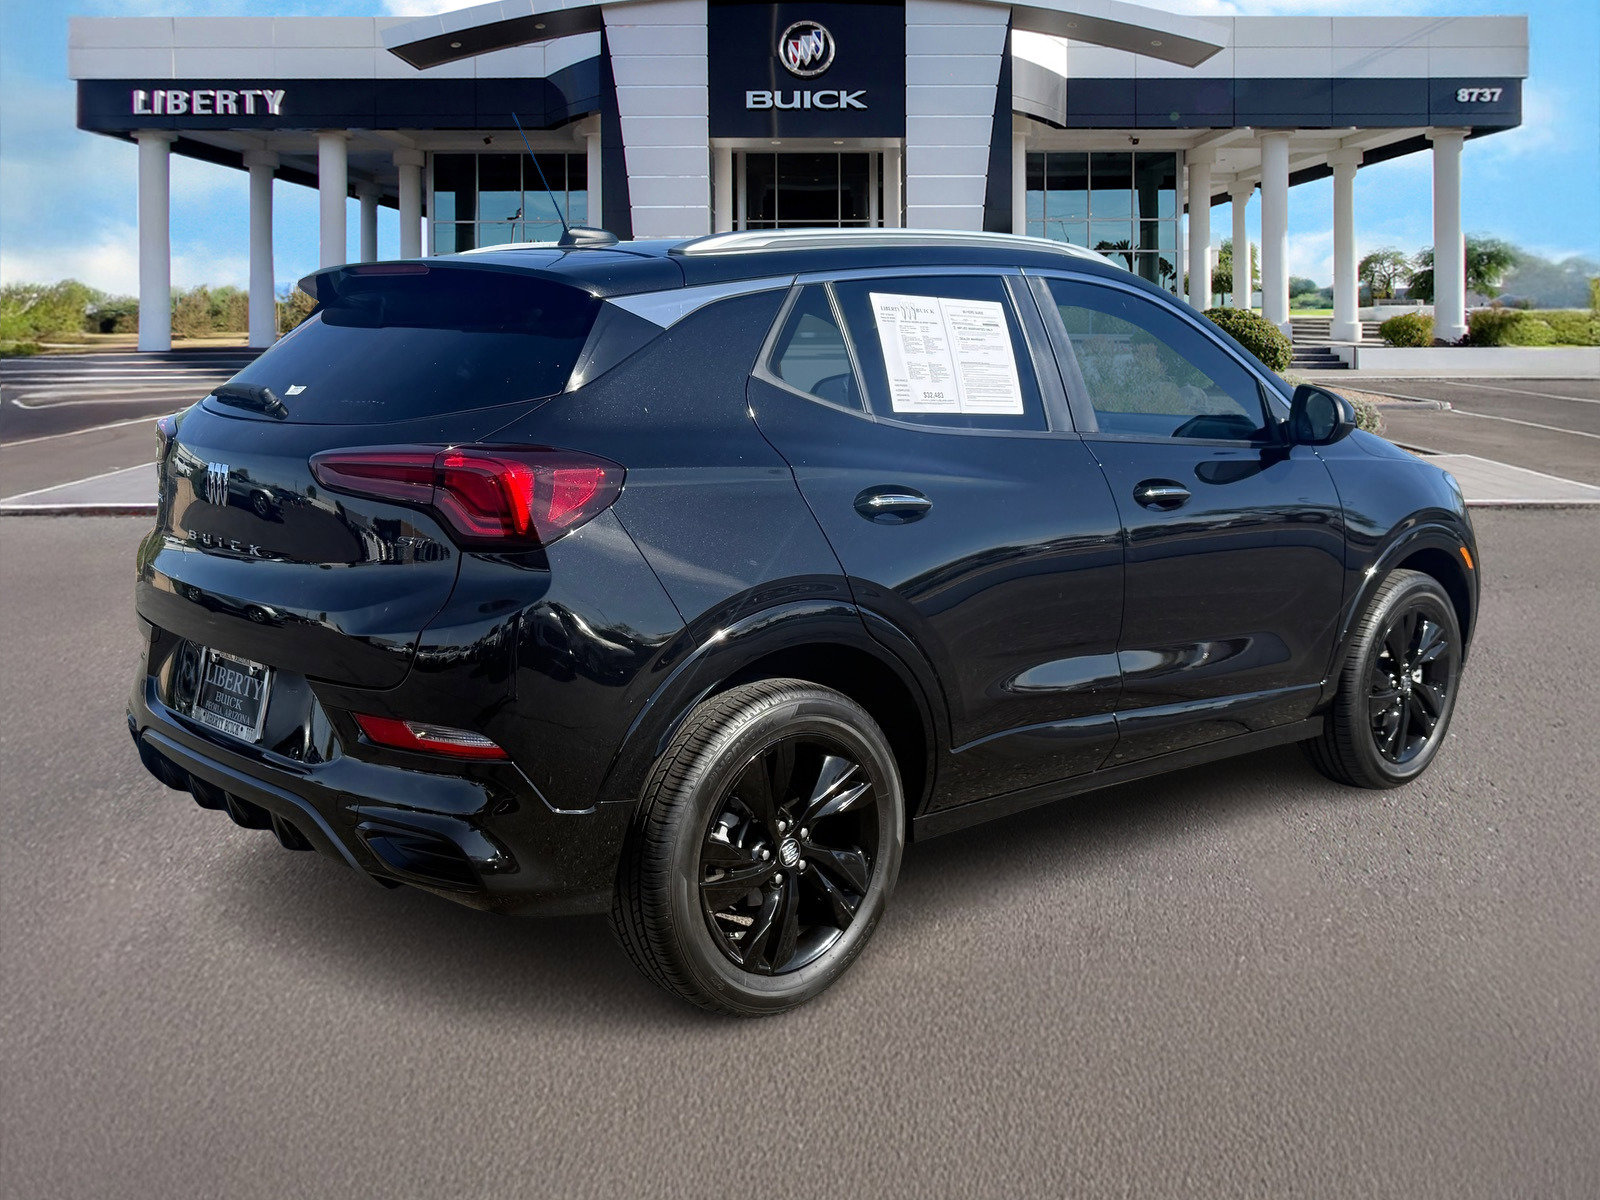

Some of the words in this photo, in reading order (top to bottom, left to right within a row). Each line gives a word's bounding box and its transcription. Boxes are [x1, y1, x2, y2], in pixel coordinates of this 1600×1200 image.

[132, 89, 285, 115] LIBERTY
[745, 90, 868, 109] BUICK
[1456, 88, 1503, 103] 8737
[188, 529, 262, 557] BUICK
[205, 661, 264, 700] LIBERTY
[215, 691, 243, 710] BUICK
